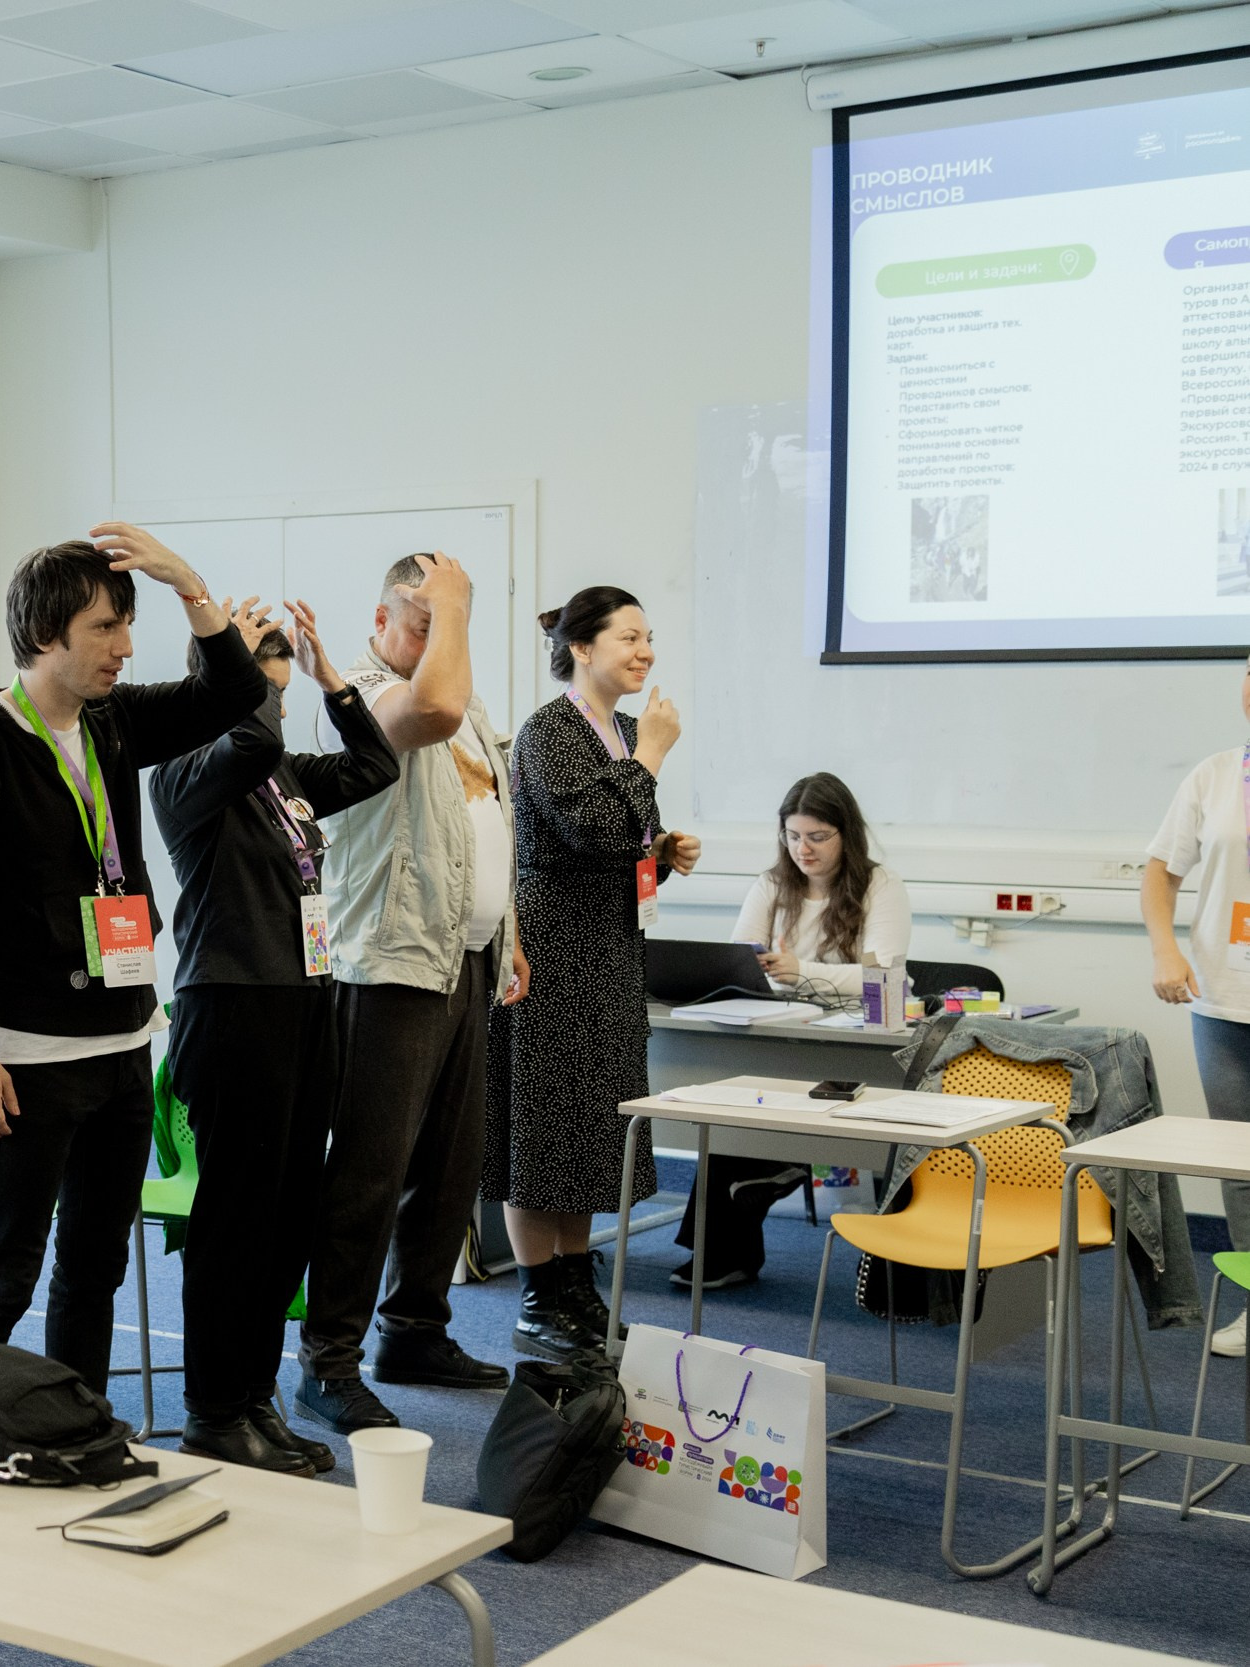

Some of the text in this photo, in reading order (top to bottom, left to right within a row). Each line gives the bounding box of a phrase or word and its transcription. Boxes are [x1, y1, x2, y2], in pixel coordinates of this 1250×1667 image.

[852, 157, 993, 190] ПРОВОДНИК
[851, 185, 965, 214] СМЫСЛОВ
[1195, 237, 1250, 252] Самоп
[925, 262, 1043, 287] Цели и задачи:
[1182, 299, 1219, 312] туров
[1222, 297, 1239, 306] по
[887, 309, 984, 327] Цель участников:
[887, 319, 1022, 340] доработка и защита тех.
[887, 341, 915, 353] карт.
[1182, 338, 1224, 352] школу
[887, 353, 929, 365] Задачи:
[900, 361, 996, 377] Познакомиться с
[1181, 365, 1247, 379] на Белуху.
[899, 376, 968, 390] ценностями
[1181, 376, 1250, 391] Всероссий
[899, 387, 976, 402] Проводников
[899, 399, 1001, 415] Представить свои
[1180, 405, 1230, 419] первый
[898, 423, 1024, 441] Сформировать четкое
[897, 436, 1021, 453] понимание основных
[897, 450, 991, 465] направлений по
[897, 464, 956, 479] доработке
[1178, 461, 1211, 473] 2024
[1212, 461, 1220, 471] в
[897, 478, 951, 492] Защитить
[104, 945, 150, 956] УЧАСТНИК
